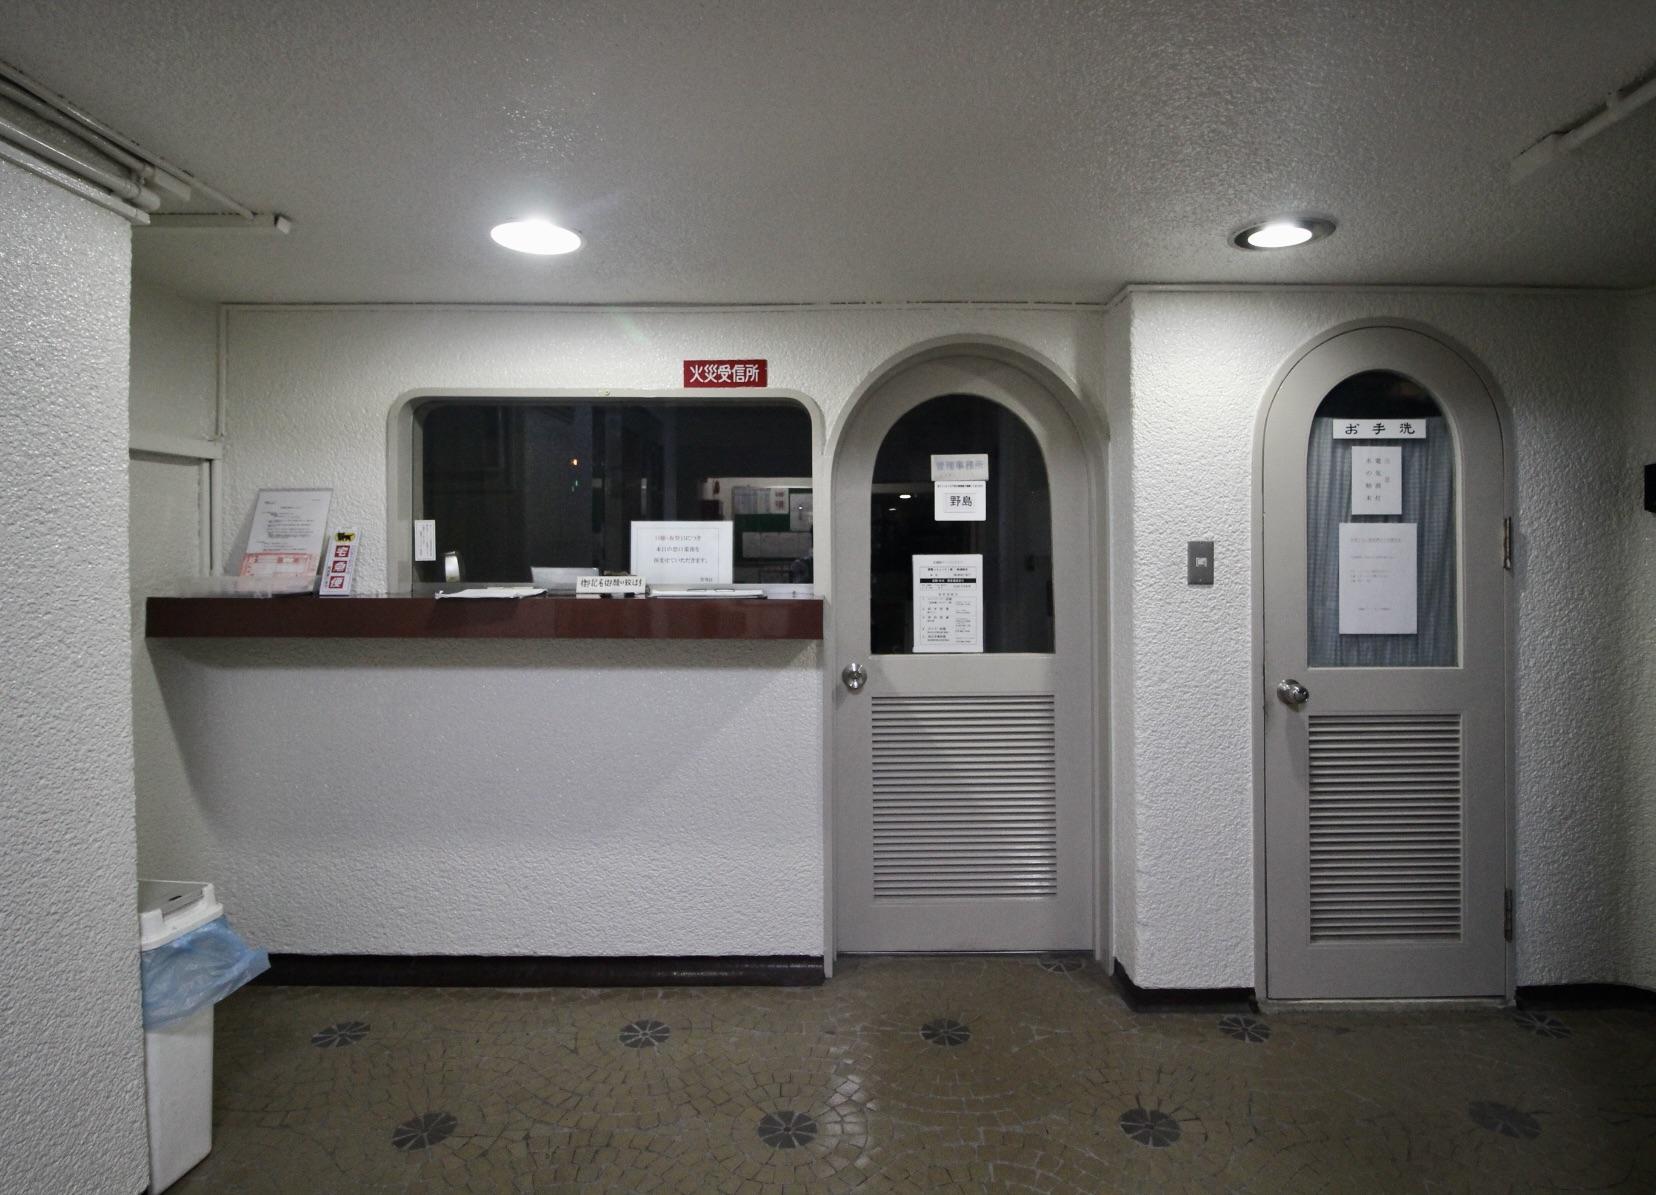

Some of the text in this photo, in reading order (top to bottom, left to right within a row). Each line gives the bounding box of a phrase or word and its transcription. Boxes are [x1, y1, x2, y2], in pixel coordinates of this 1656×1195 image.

[689, 364, 760, 383] 火災受信所
[1344, 423, 1416, 435] お手洗
[949, 495, 973, 507] 野島
